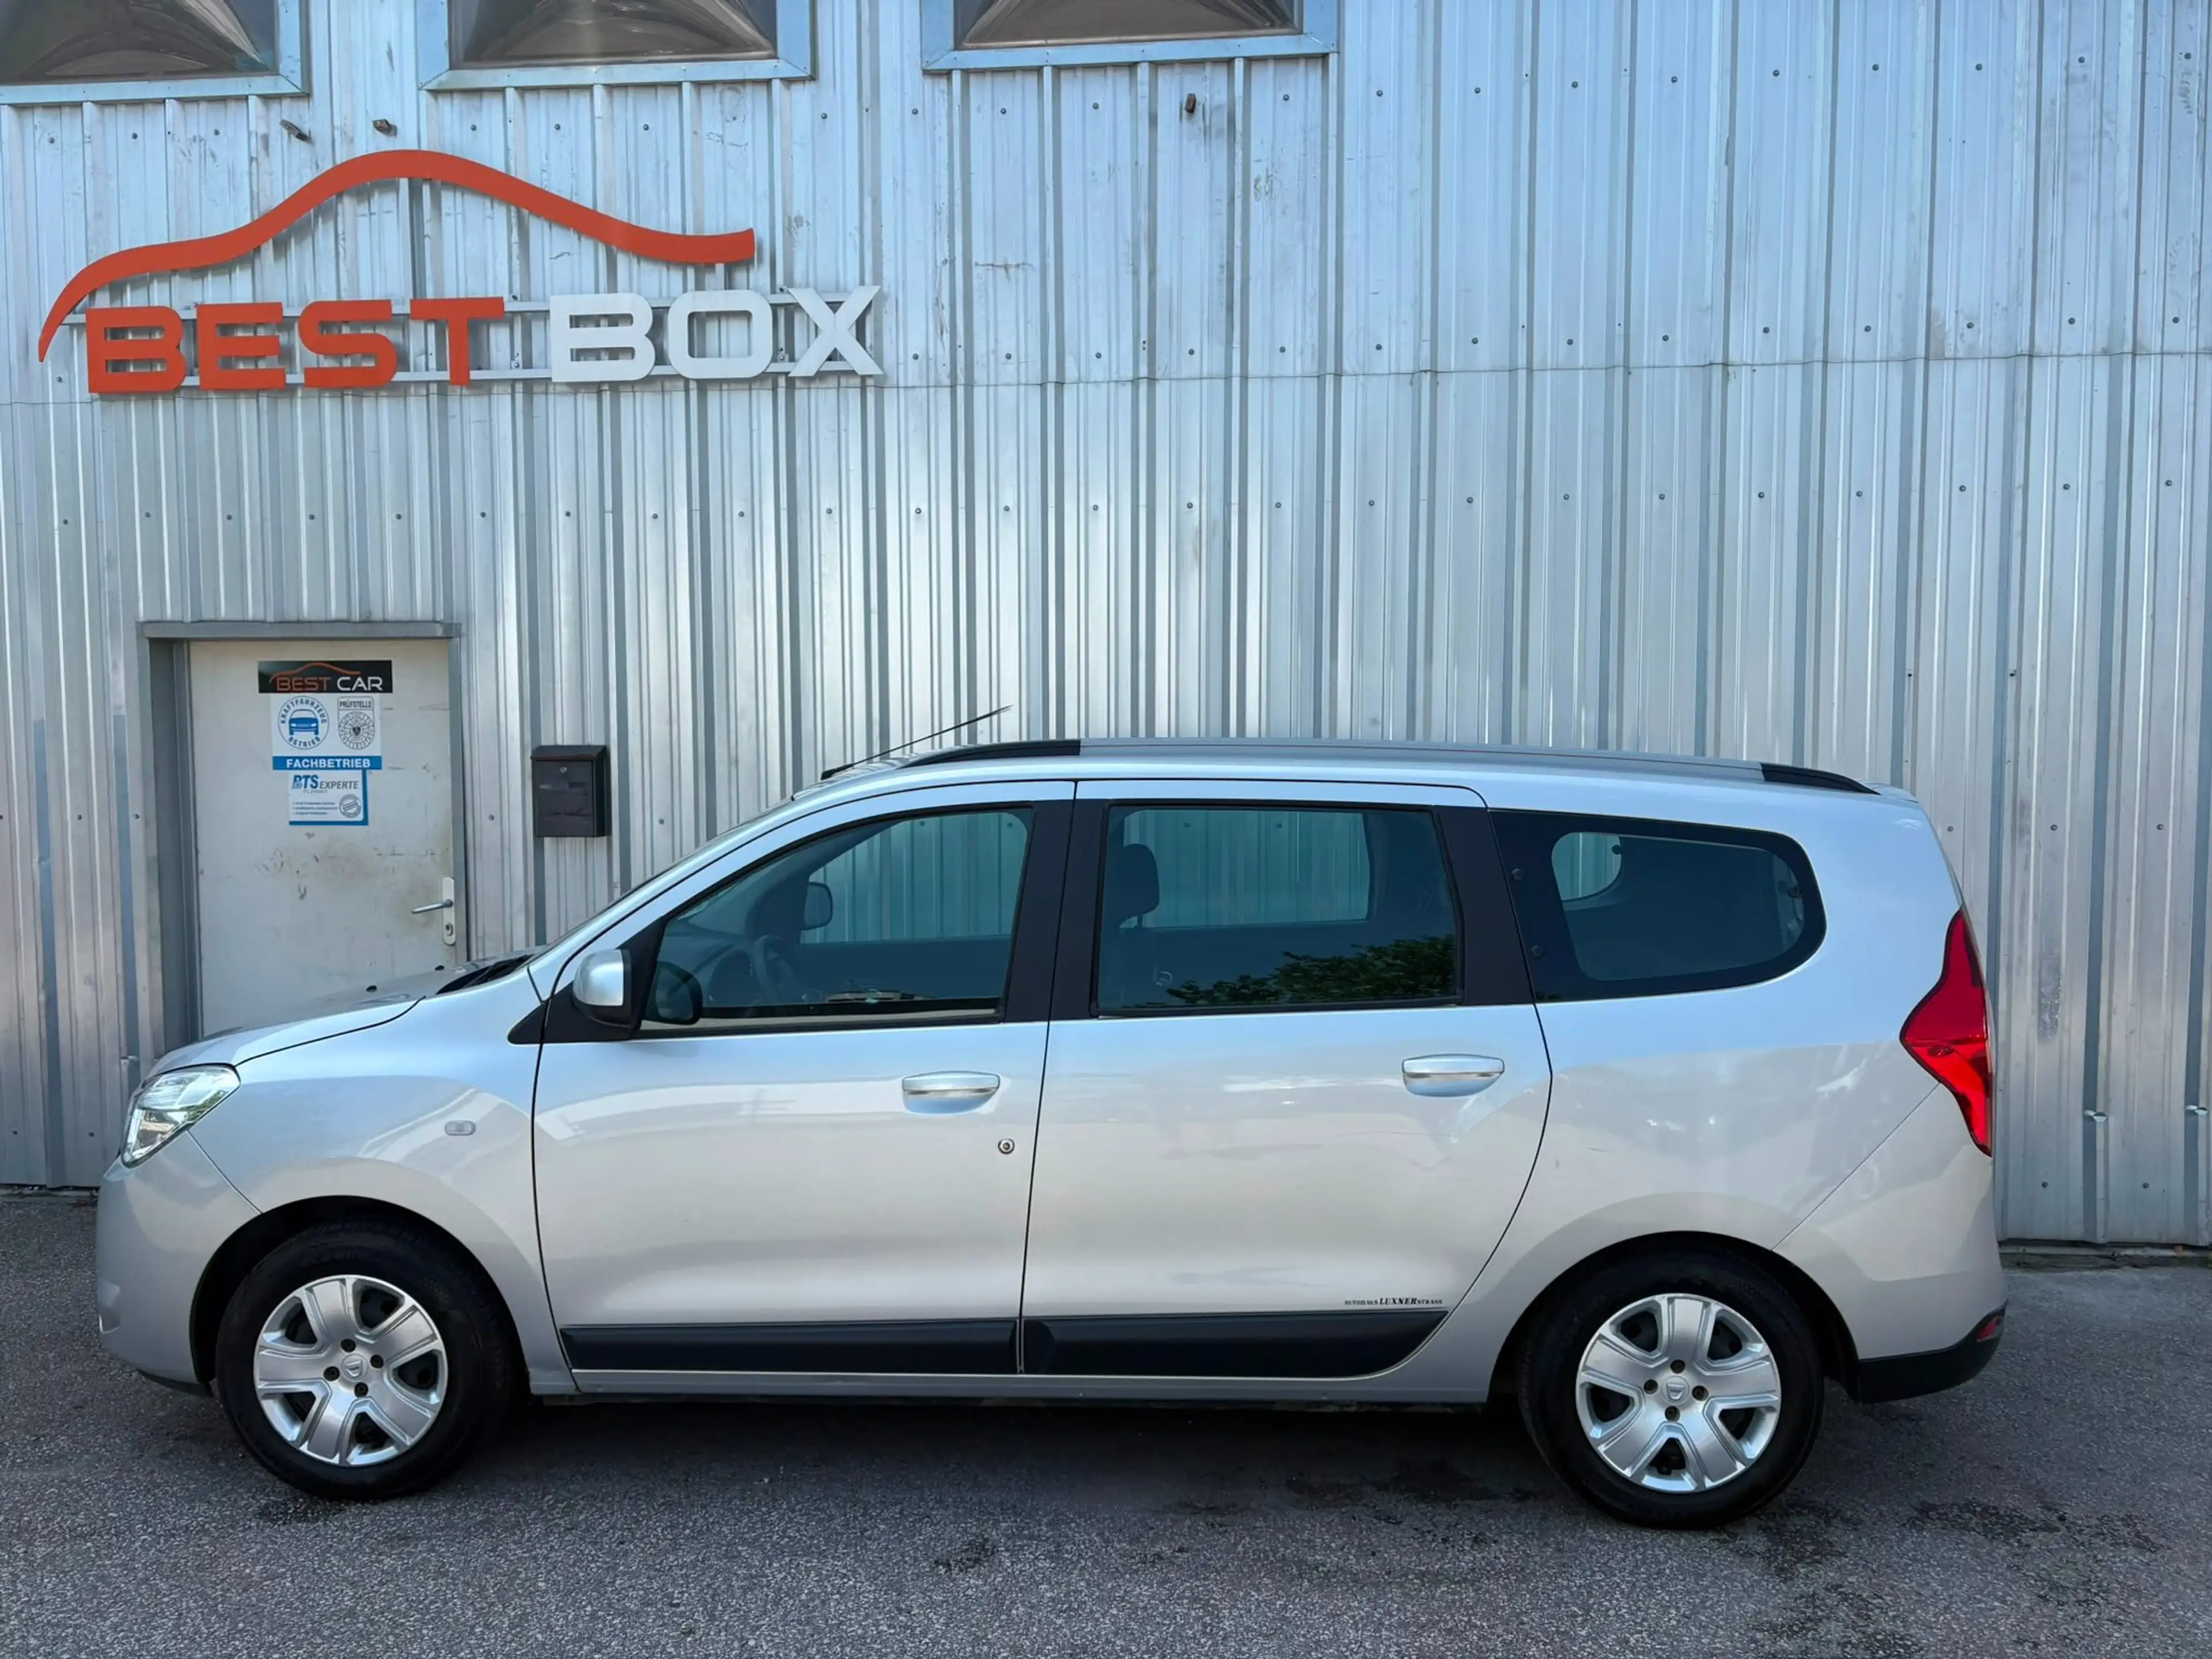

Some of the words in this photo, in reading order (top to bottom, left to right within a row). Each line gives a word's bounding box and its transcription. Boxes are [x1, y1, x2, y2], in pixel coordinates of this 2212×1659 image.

[86, 296, 505, 393] BEST
[550, 285, 884, 382] BOX
[276, 677, 331, 691] BEST
[336, 676, 383, 691] CAR
[286, 758, 371, 768] FACHBETRIEB
[319, 781, 359, 789] EXPERTE
[1379, 1297, 1418, 1305] LUXNER
